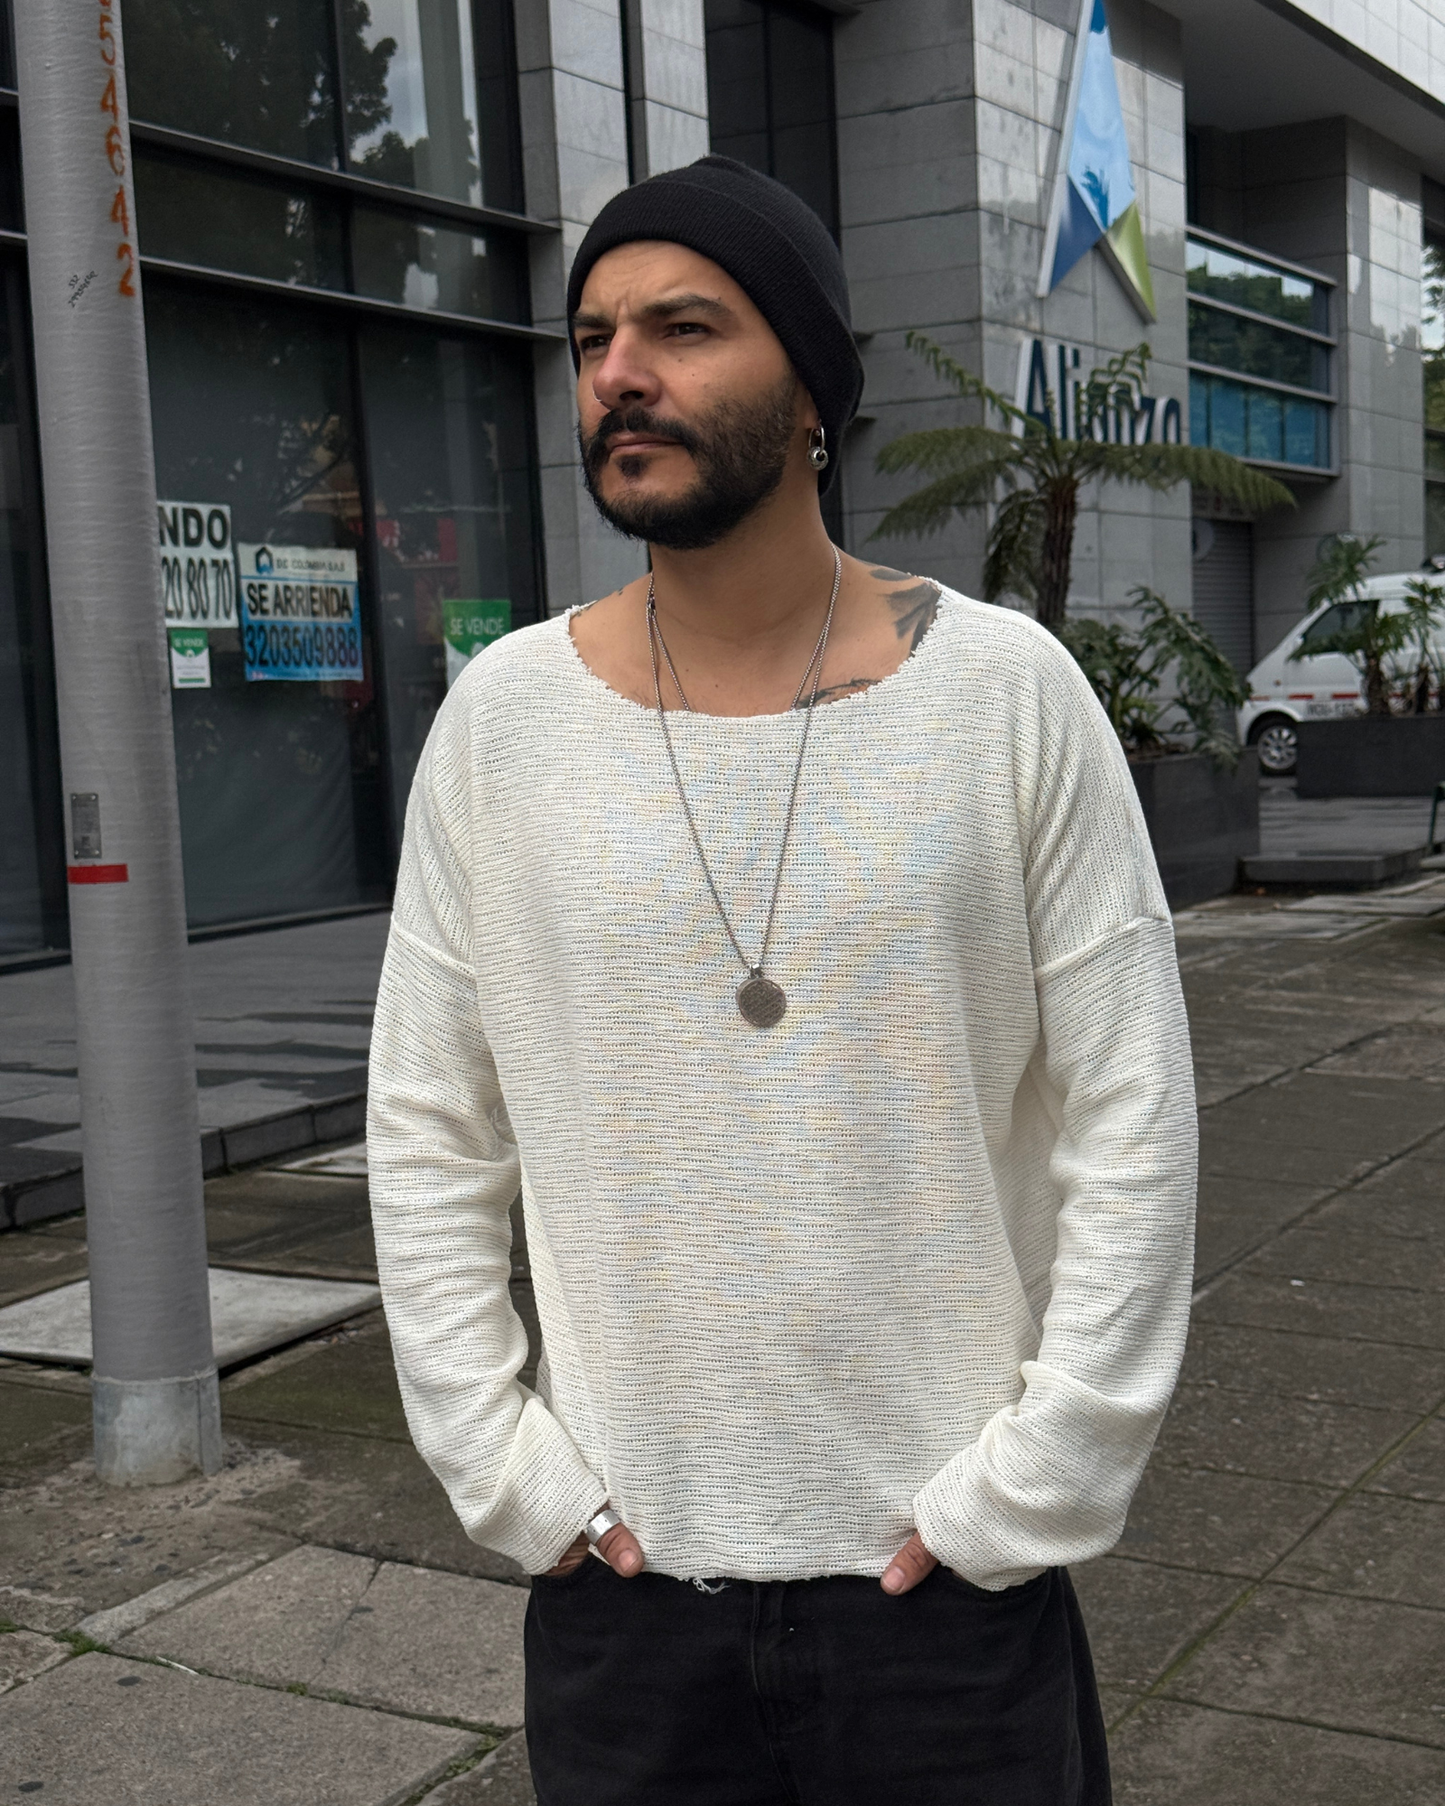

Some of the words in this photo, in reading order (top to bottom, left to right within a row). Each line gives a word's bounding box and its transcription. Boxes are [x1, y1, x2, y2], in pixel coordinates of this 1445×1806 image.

[98, 0, 136, 297] 54642
[247, 582, 269, 616] SE
[273, 584, 352, 619] ARRIENDA
[245, 625, 359, 668] 3203509888
[450, 618, 463, 635] SE
[465, 618, 505, 636] VENDE
